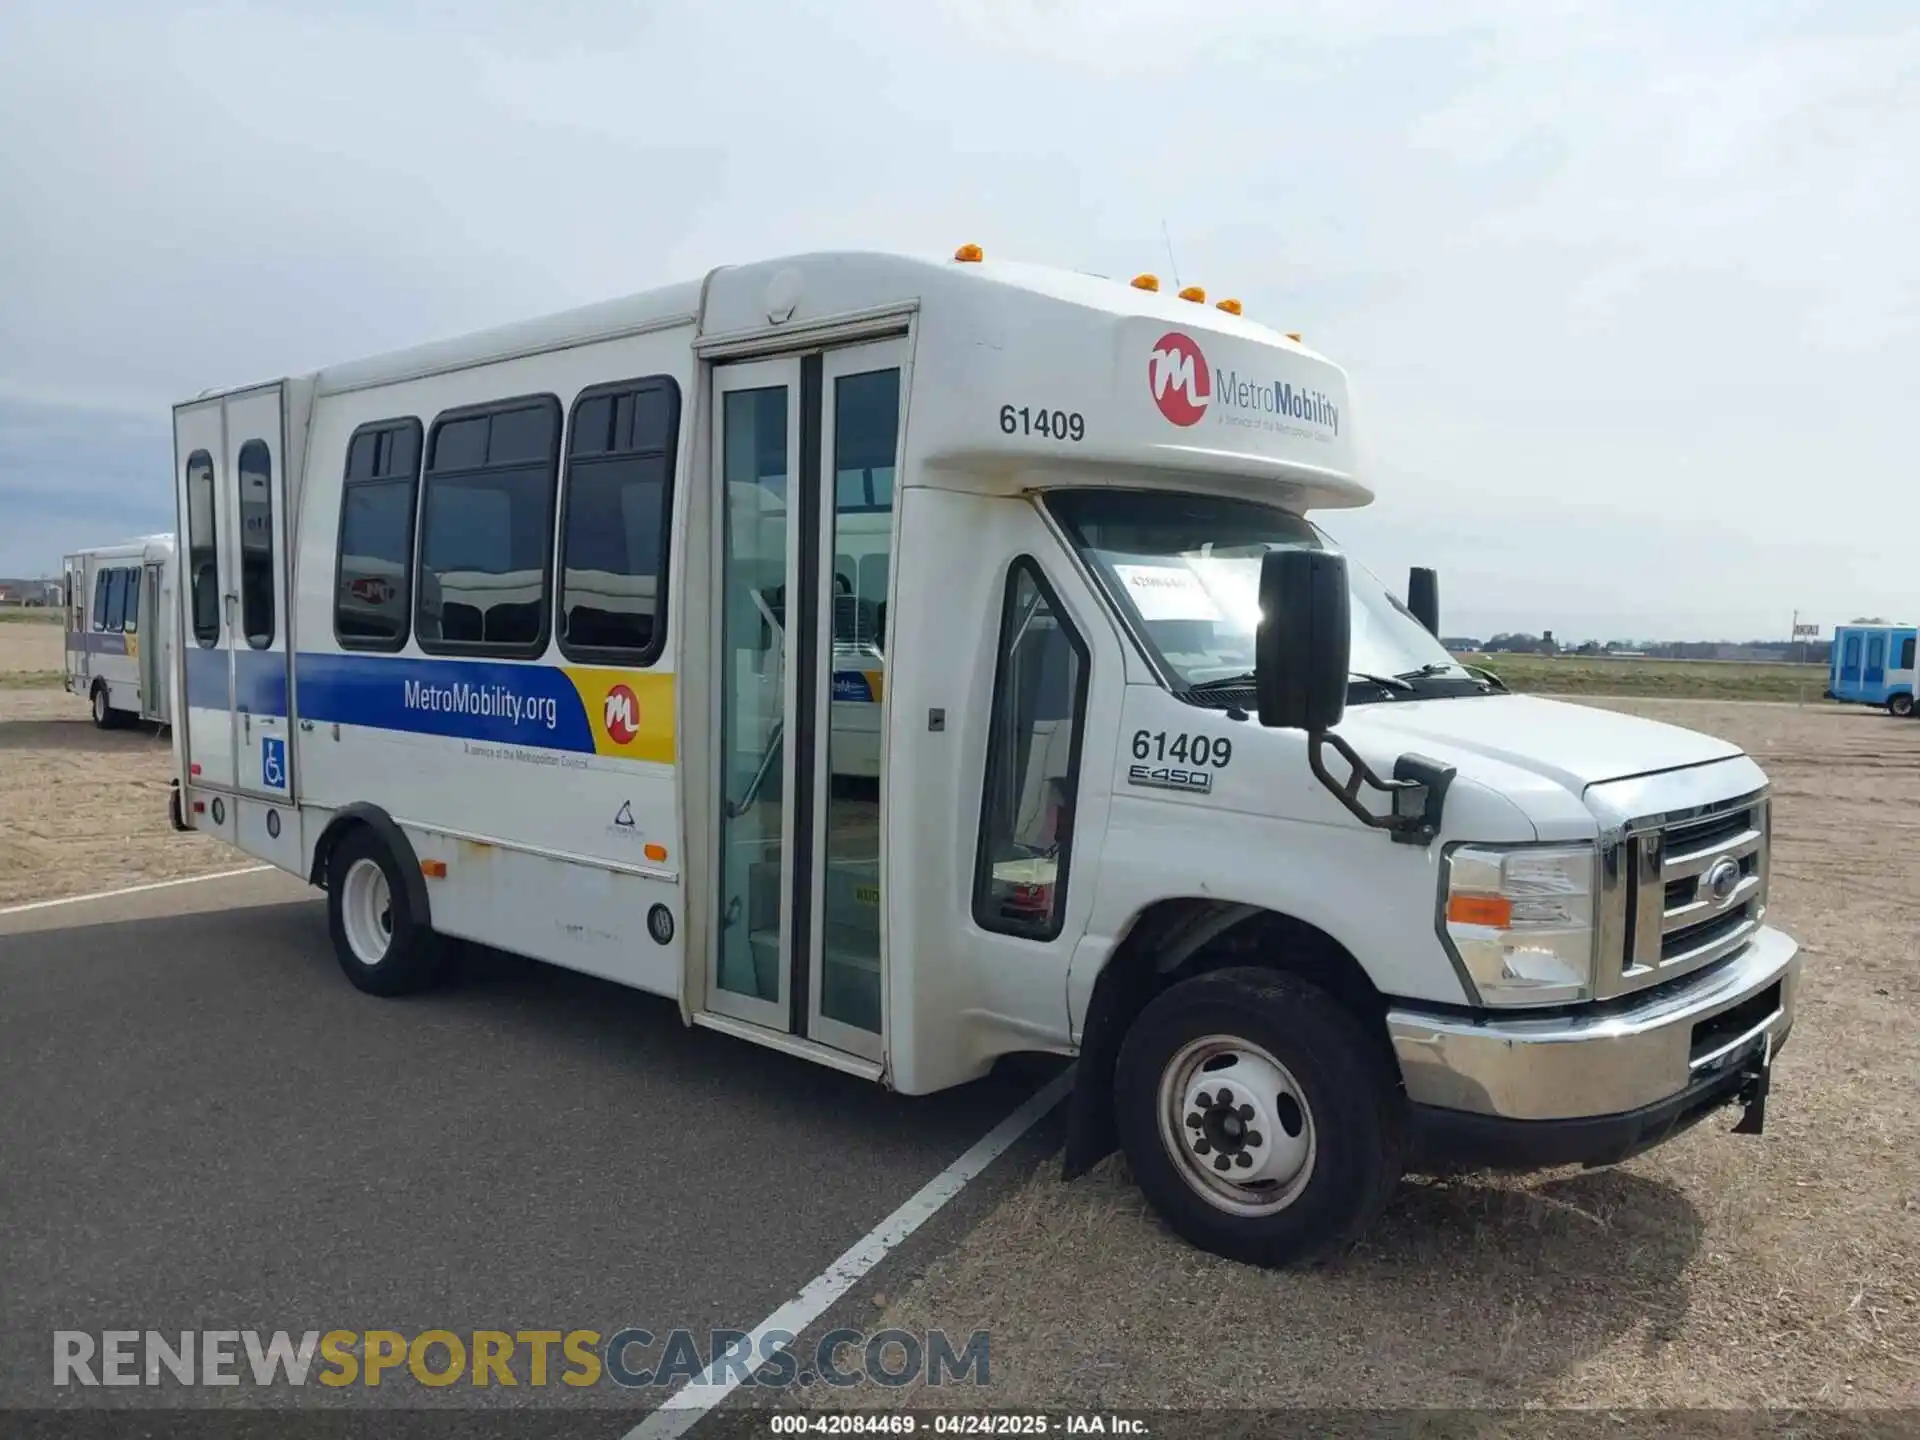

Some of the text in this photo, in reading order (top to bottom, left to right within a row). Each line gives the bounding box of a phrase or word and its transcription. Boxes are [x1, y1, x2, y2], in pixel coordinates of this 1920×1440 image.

[1216, 368, 1339, 436] MetroMobility
[1000, 404, 1085, 441] 61409
[403, 679, 557, 730] MetroMobility.org
[1132, 729, 1232, 768] 61409
[1129, 765, 1210, 786] E-450
